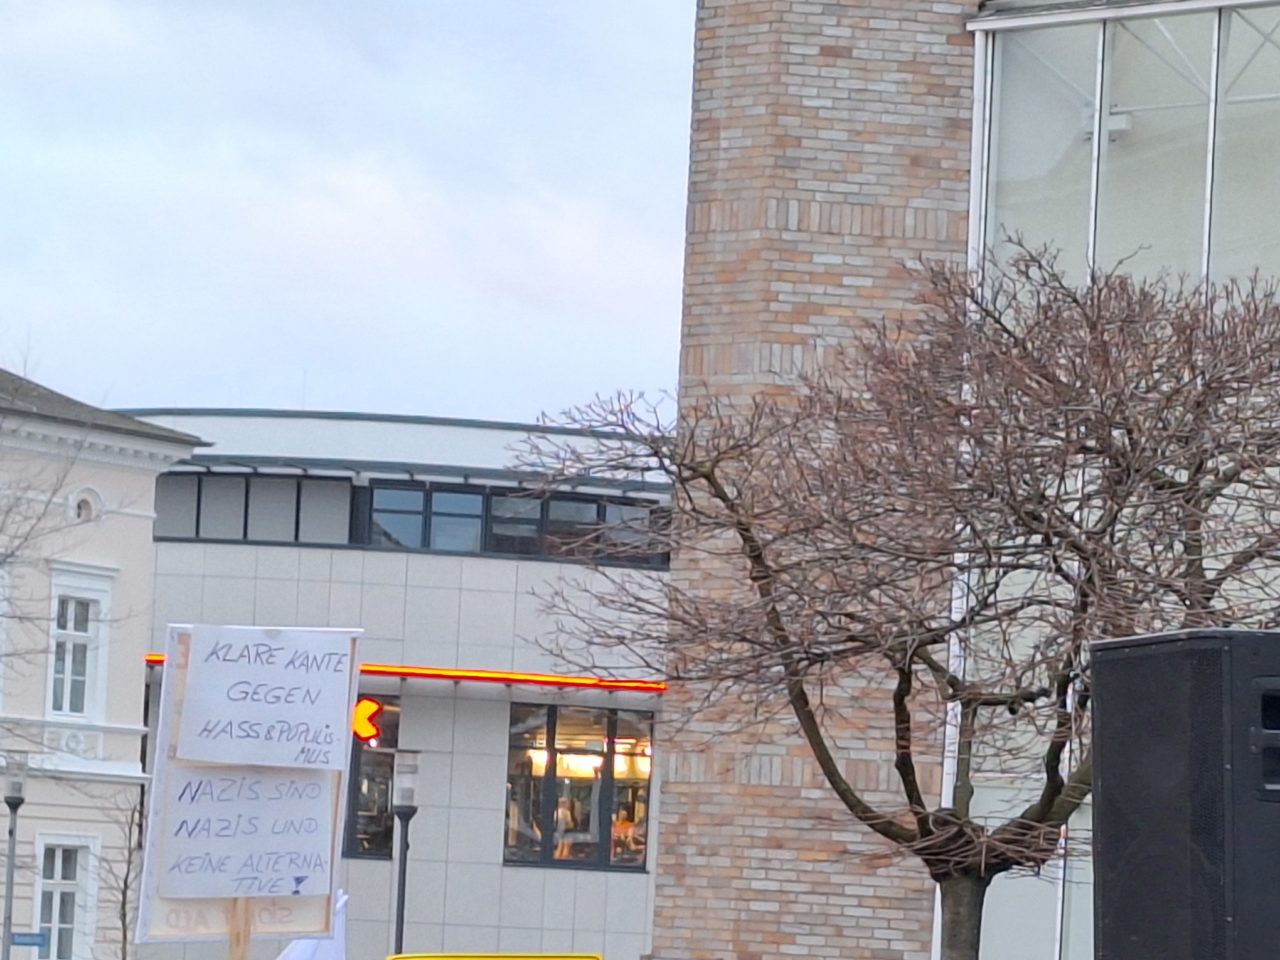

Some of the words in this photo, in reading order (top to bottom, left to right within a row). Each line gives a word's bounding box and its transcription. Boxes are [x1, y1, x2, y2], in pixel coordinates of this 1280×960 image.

[204, 641, 284, 668] KLARE
[284, 650, 348, 676] KANTE
[226, 680, 322, 706] GEGEN
[271, 816, 319, 836] UND
